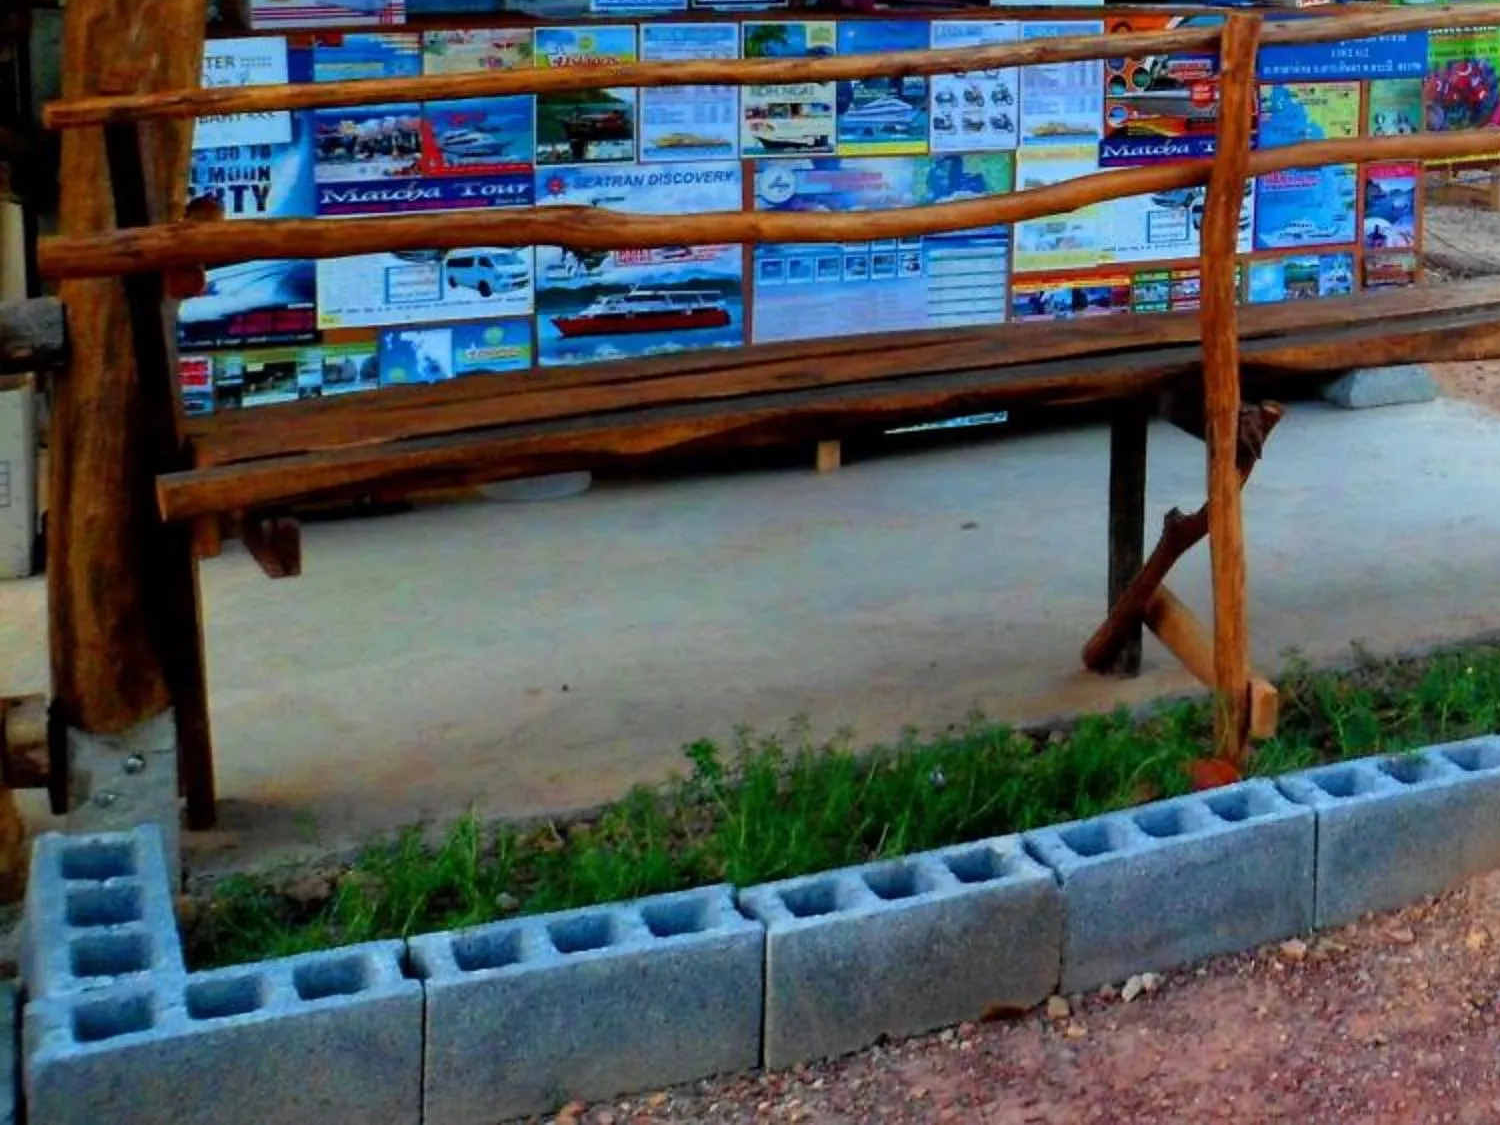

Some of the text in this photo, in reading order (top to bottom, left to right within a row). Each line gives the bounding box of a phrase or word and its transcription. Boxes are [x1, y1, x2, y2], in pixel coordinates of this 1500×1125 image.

[216, 146, 240, 160] GO
[250, 144, 272, 159] TO
[208, 165, 271, 183] MOON
[573, 171, 735, 189] SEATRAN DISCOVERY
[454, 182, 530, 197] Tour
